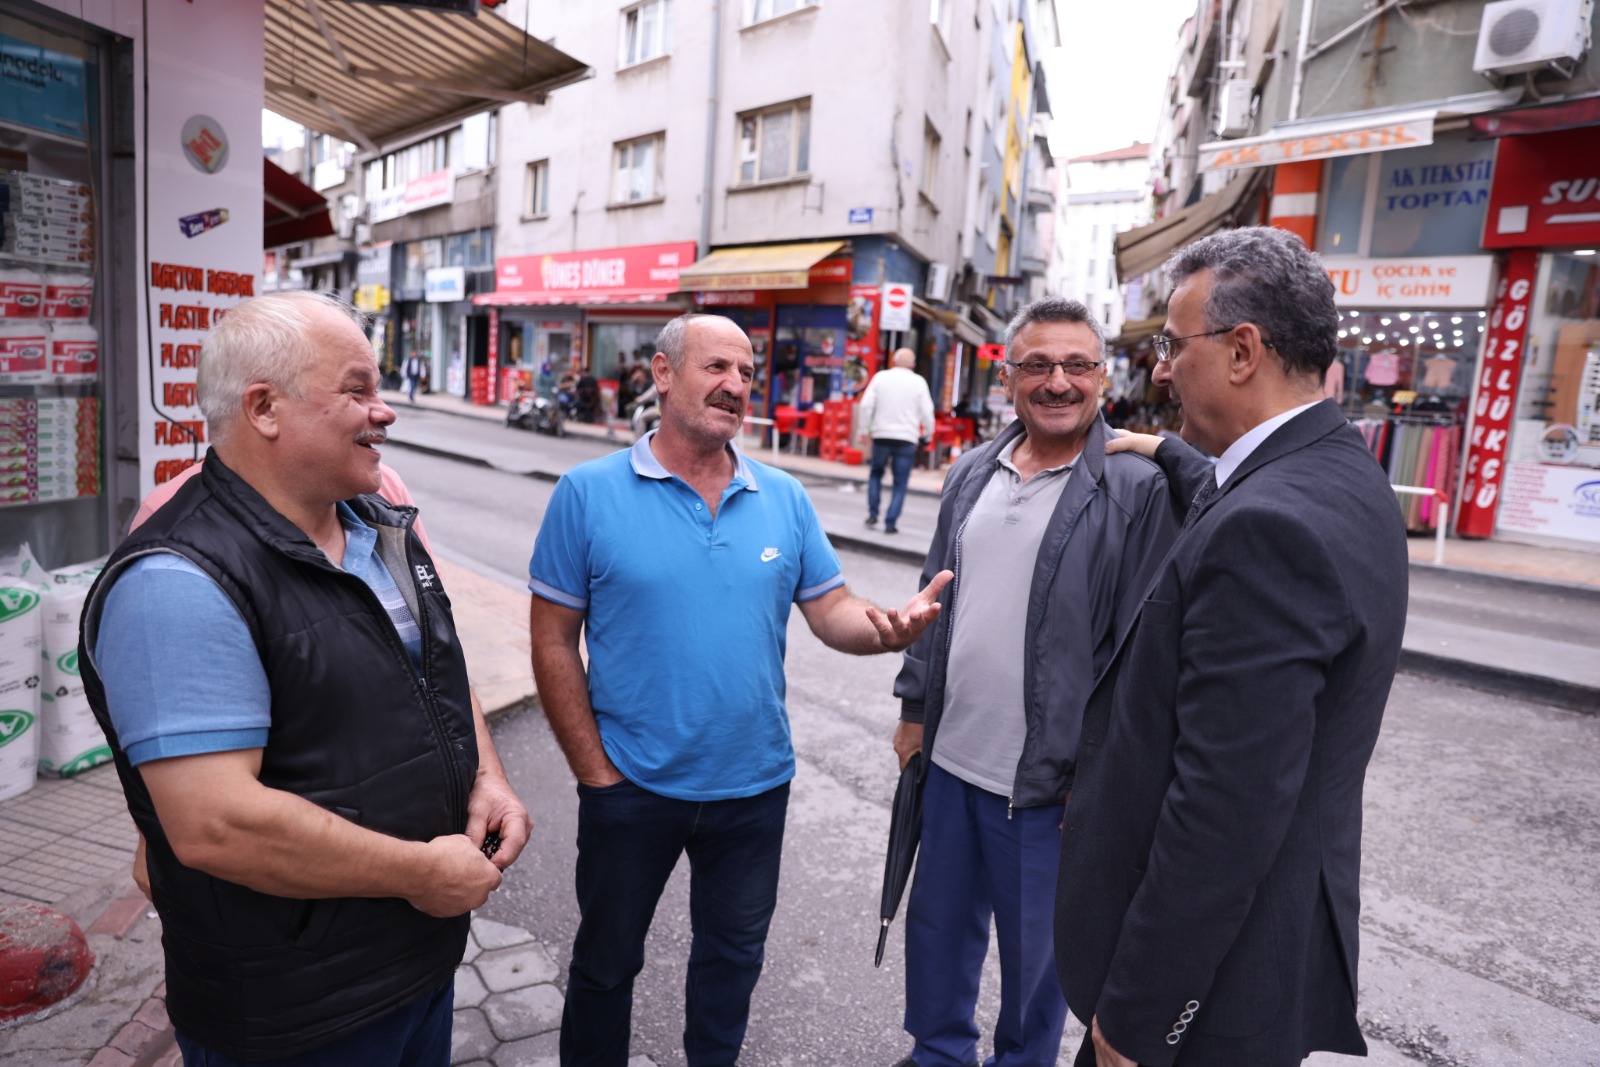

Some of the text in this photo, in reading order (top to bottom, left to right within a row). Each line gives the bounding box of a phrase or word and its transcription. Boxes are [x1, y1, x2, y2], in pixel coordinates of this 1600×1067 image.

[0, 52, 63, 82] nadolu
[1214, 146, 1261, 167] AK
[1391, 168, 1414, 187] AK
[1541, 178, 1600, 205] SU
[151, 262, 254, 297] KARTON BARDAK
[1372, 264, 1431, 281] ÇOCUK
[1399, 281, 1451, 297] GİYİM
[159, 300, 210, 331] PLASTİK
[160, 339, 202, 370] PLAST
[163, 383, 198, 408] KART
[1475, 278, 1531, 509] GÖZLÜKÇÜ
[155, 415, 205, 446] PLASTİK
